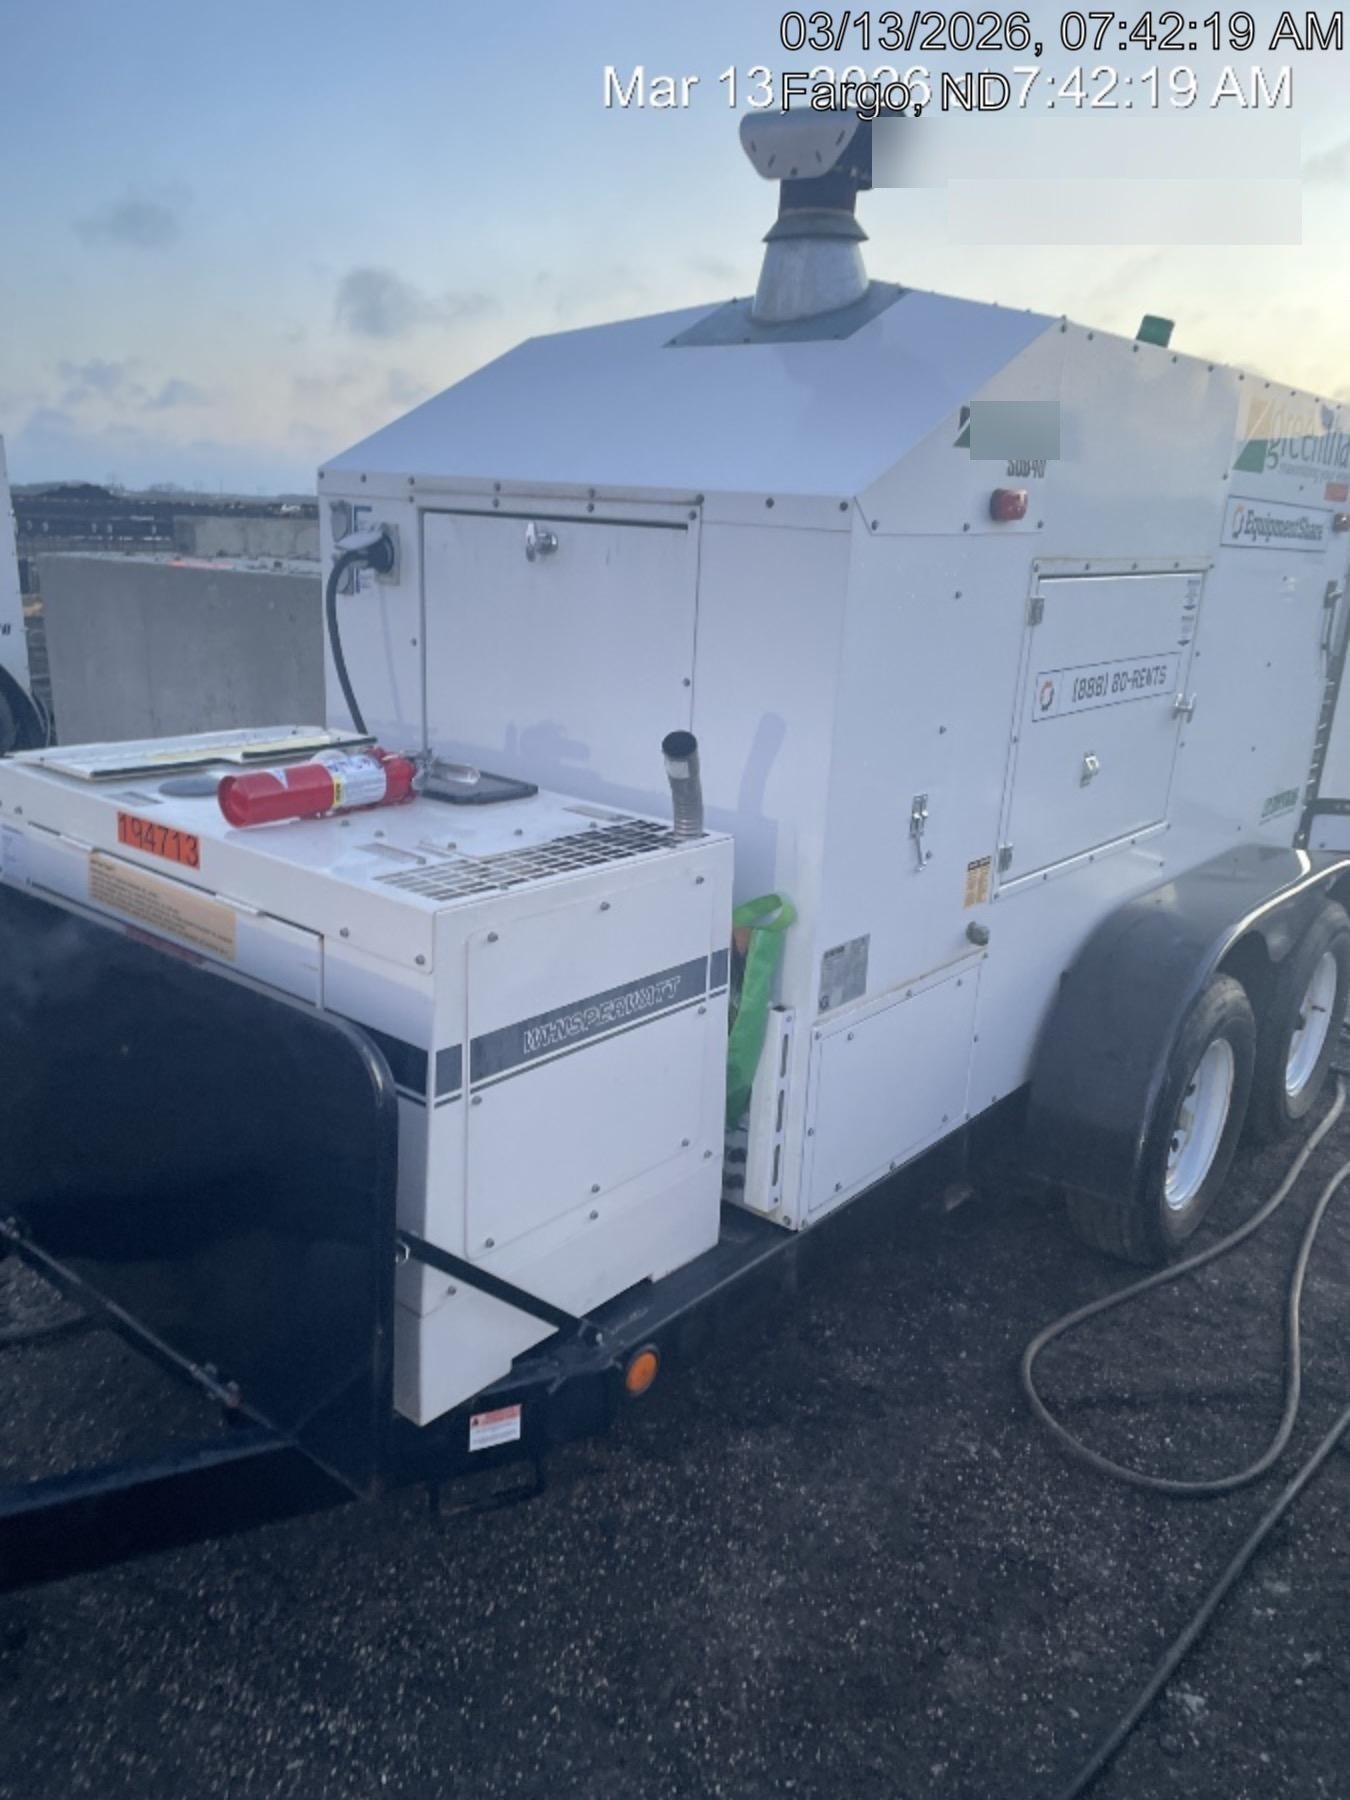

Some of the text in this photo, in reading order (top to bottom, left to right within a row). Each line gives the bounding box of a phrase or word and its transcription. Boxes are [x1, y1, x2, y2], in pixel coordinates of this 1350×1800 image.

[1071, 671, 1110, 703] (888)
[118, 812, 200, 867] 194713
[523, 975, 682, 1054] WHISPERWATT
